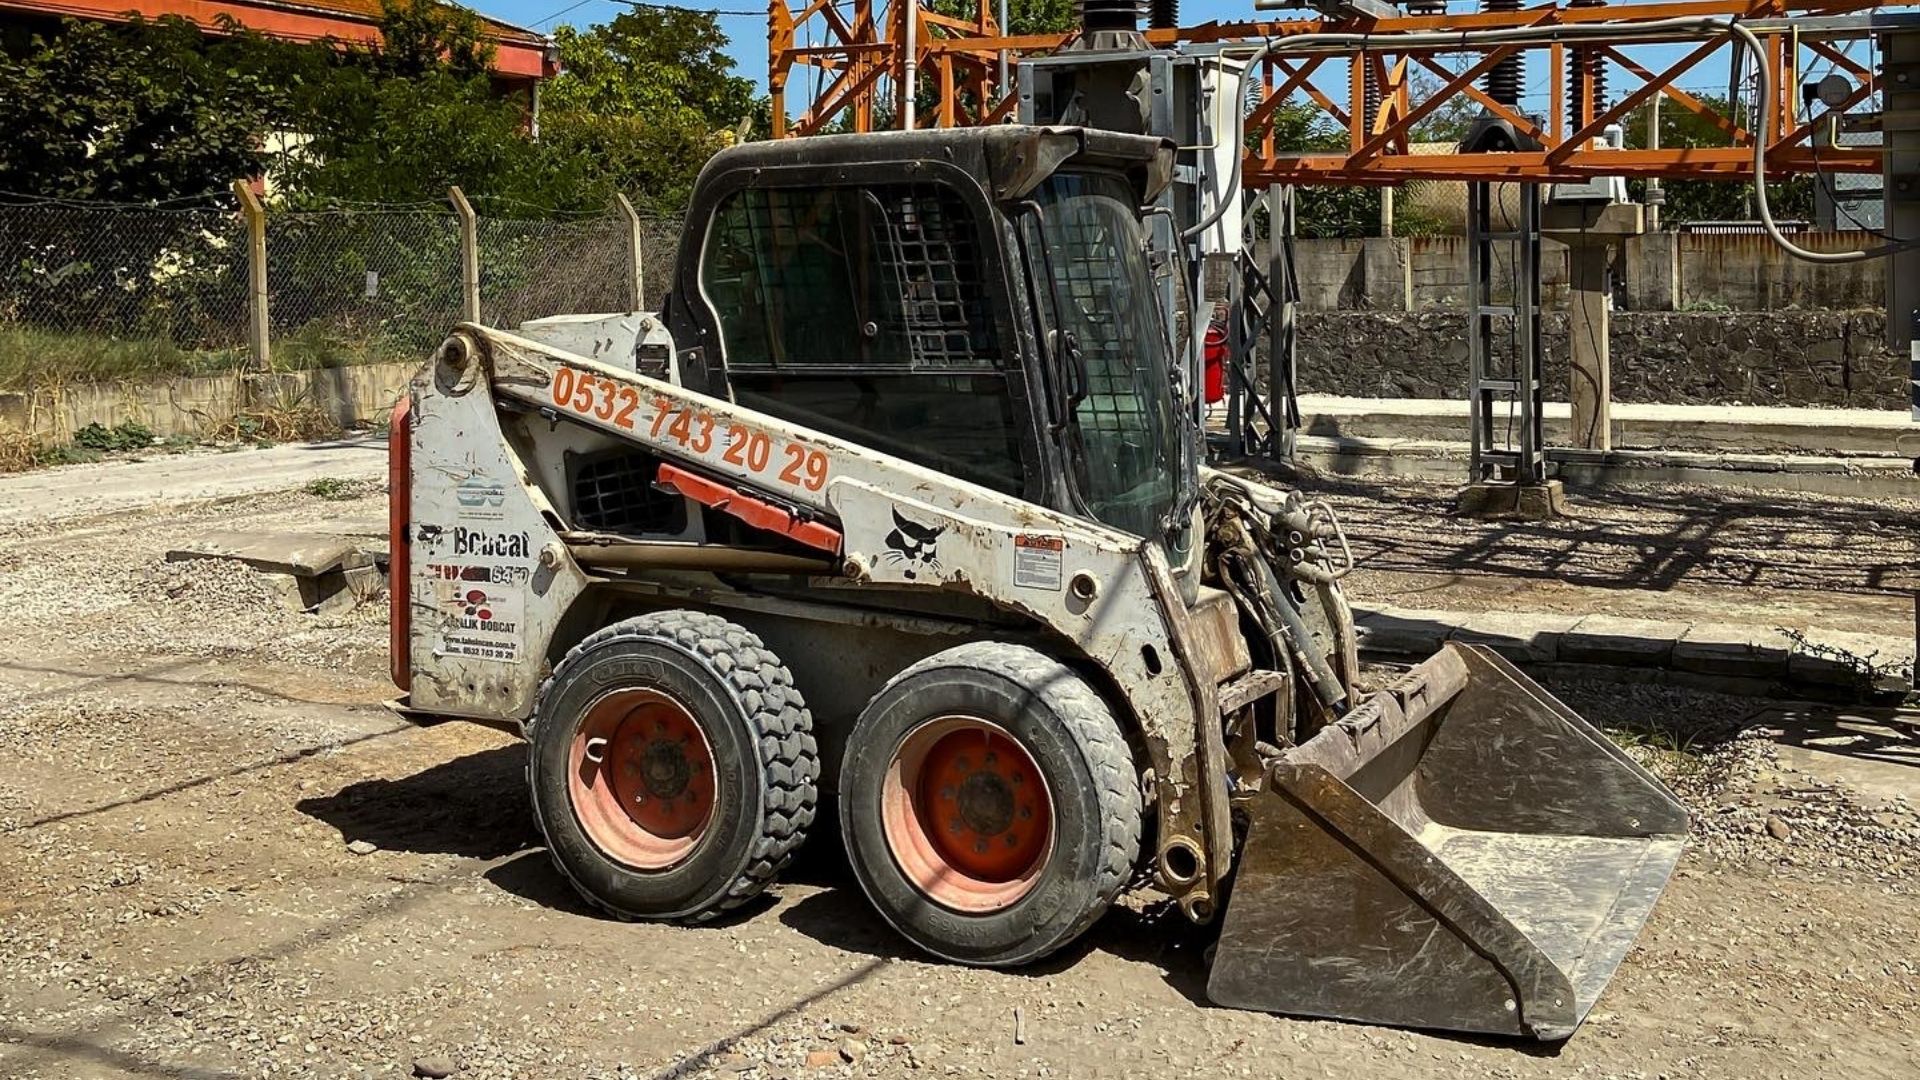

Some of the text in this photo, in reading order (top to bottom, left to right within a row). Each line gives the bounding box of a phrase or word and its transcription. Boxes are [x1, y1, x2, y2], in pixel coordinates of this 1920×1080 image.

[553, 368, 828, 492] 0532 743 20 29
[454, 526, 529, 558] Bobcat
[481, 620, 515, 634] BOBCAT
